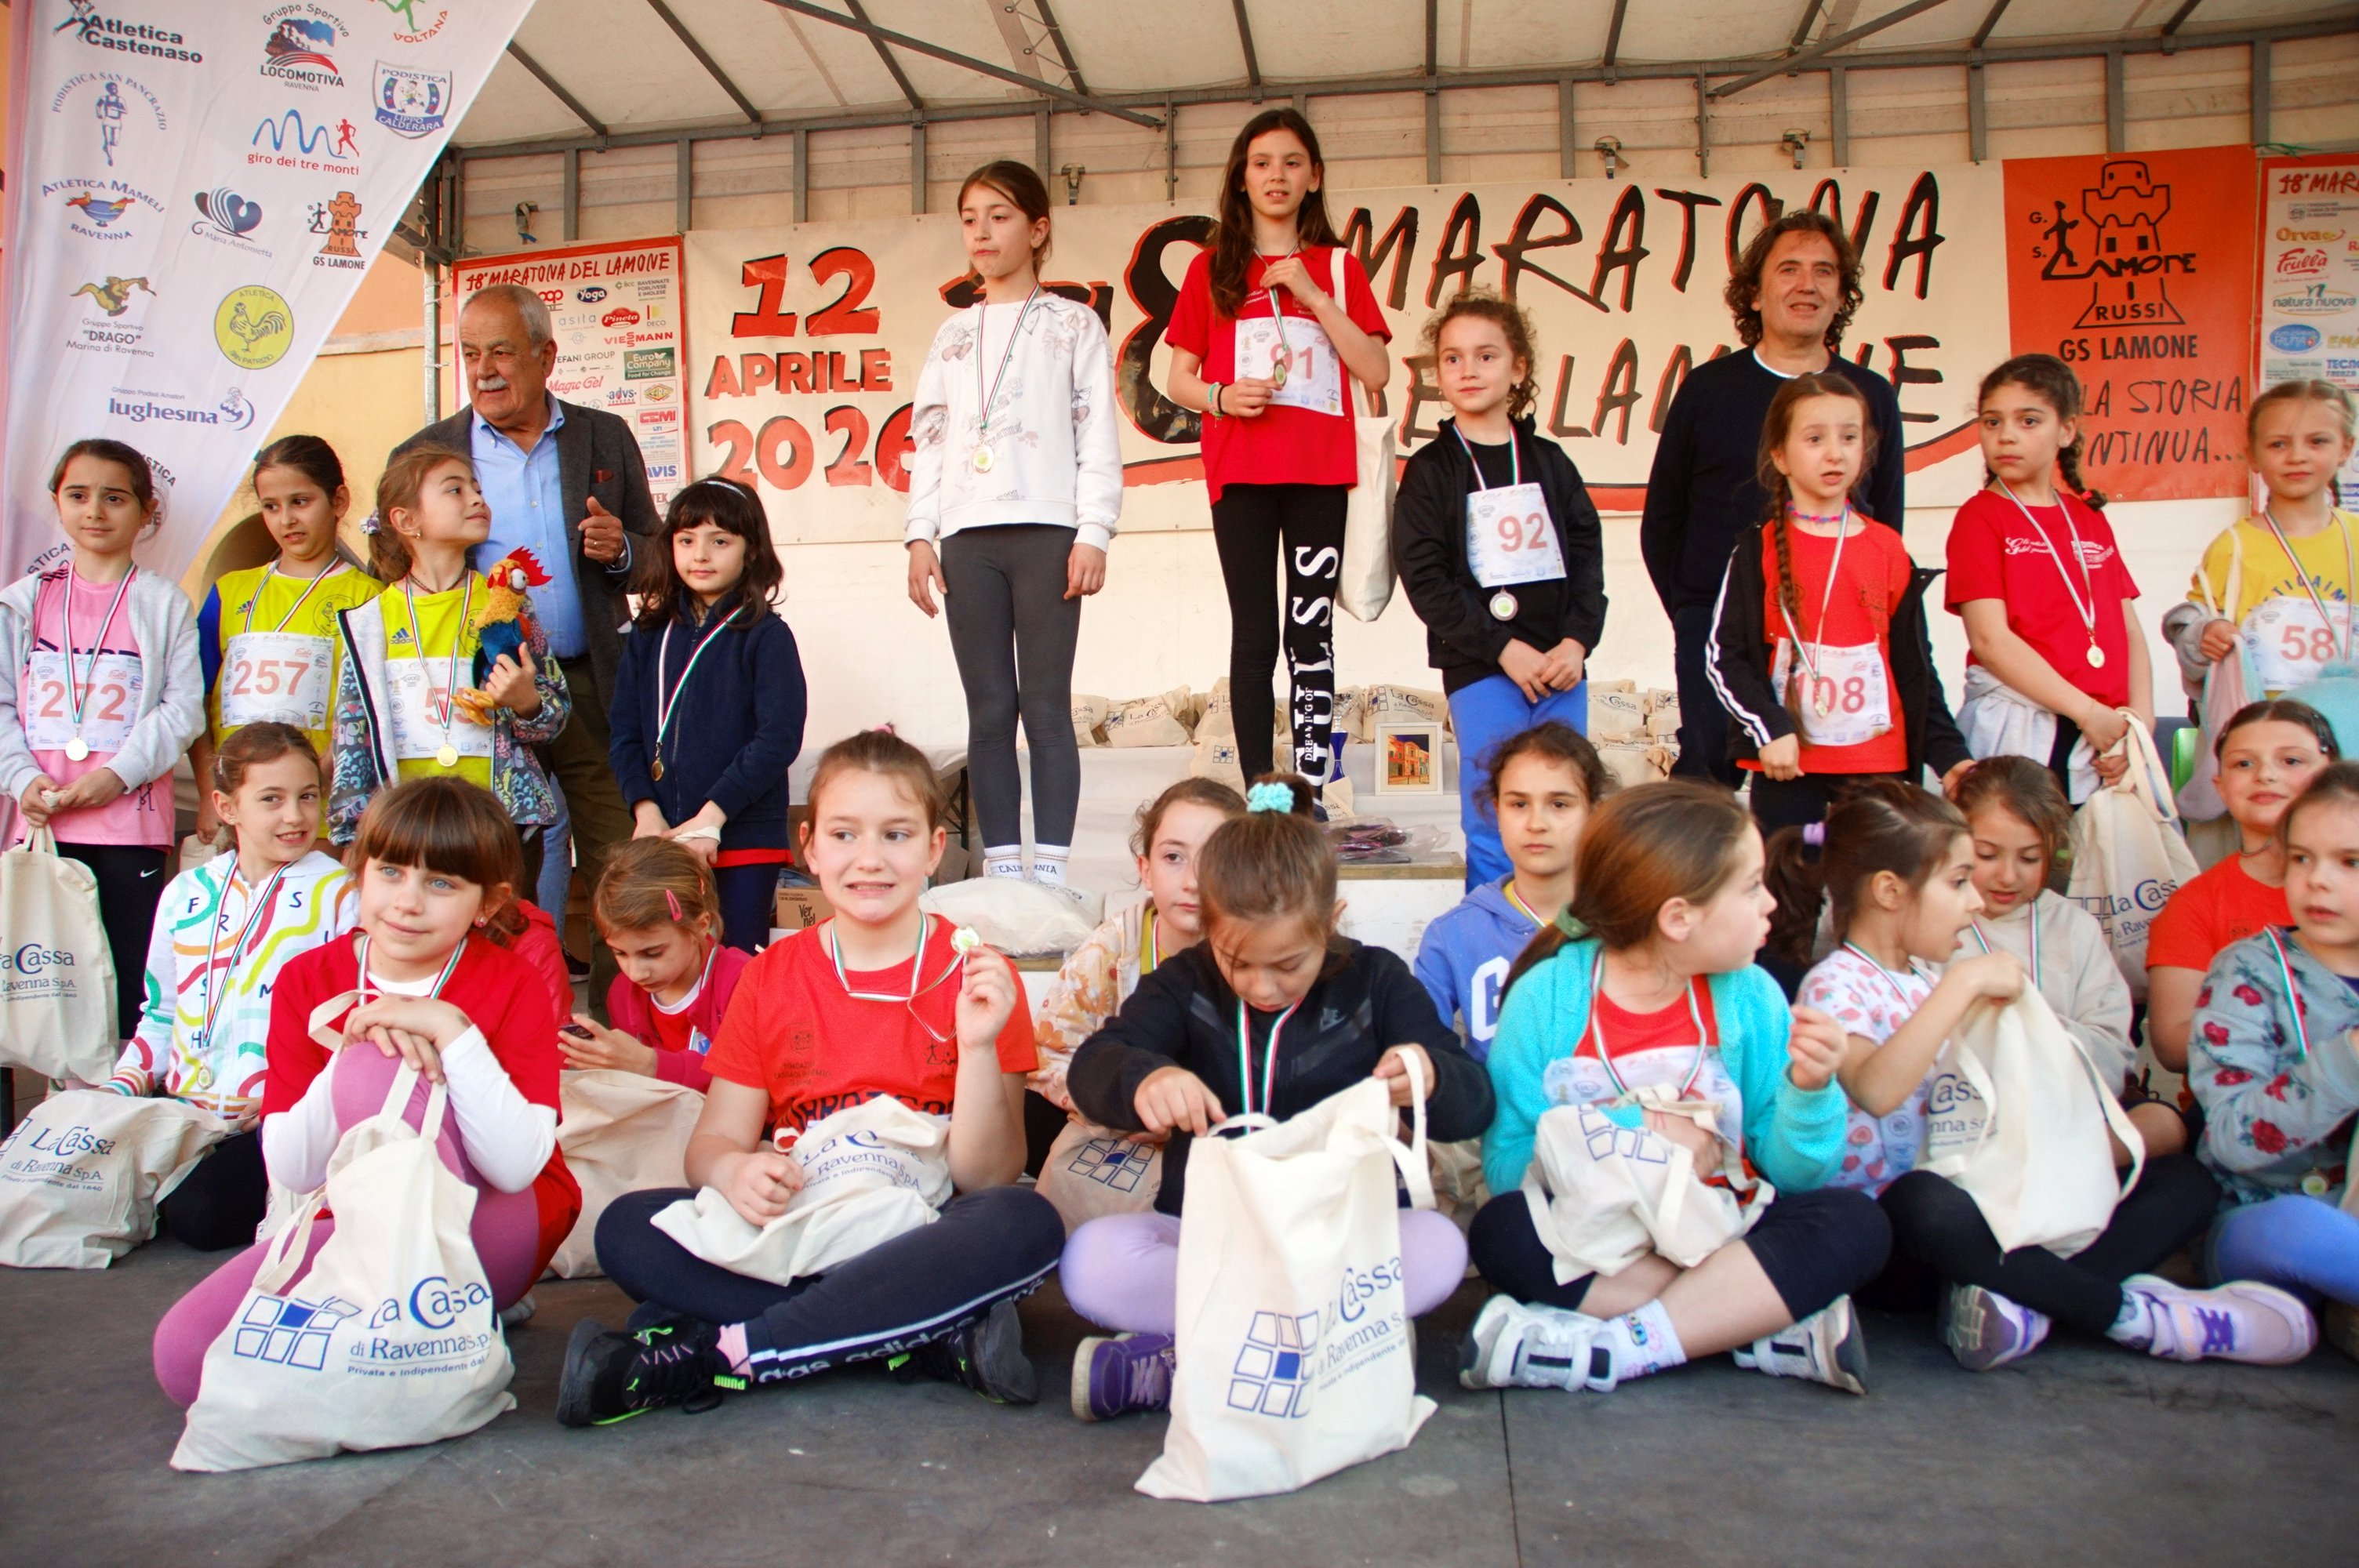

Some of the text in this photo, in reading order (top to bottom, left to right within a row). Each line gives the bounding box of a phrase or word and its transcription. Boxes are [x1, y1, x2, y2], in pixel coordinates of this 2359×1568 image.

[89, 14, 184, 45] Atletica
[263, 3, 350, 38] Gruppo Sportivo
[394, 10, 448, 44] VOLTANA
[85, 30, 203, 64] Castenaso
[260, 65, 345, 88] LOCOMOTIVA
[284, 81, 320, 93] RAVENNA
[382, 68, 448, 84] PODISTICA
[52, 71, 167, 131] PODISTICA SAN PANCRAZIO
[379, 115, 441, 132] CALDERARA
[394, 114, 424, 124] LIPPO
[247, 152, 360, 176] giro dei tre monti
[42, 179, 165, 212] ATLETICA MAMELI
[71, 223, 133, 240] RAVENNA
[313, 256, 366, 270] GS LAMONE
[489, 263, 565, 285] MARATONA
[570, 261, 600, 279] DEL
[605, 252, 670, 275] LAMONE
[238, 289, 274, 302] ATLETICA
[539, 289, 564, 303] oop
[580, 288, 605, 302] Yoga
[731, 246, 881, 338] 12
[2273, 297, 2357, 307] natura nuova
[604, 314, 638, 323] Pineta
[2095, 302, 2165, 321] RUSSI
[557, 351, 616, 364] EFANI GROUP
[633, 354, 655, 362] Euro
[2059, 334, 2197, 362] GS LAMONE
[627, 359, 671, 369] Company
[1270, 343, 1314, 380] 91
[549, 375, 605, 394] Magic Gel
[704, 348, 893, 400] APRILE
[2128, 376, 2243, 414] STORIA
[108, 397, 219, 425] lughesina
[707, 401, 914, 492] 2026
[2088, 426, 2245, 467] NTINUA...
[1498, 512, 1548, 552] 92
[2280, 625, 2335, 663] 58
[232, 659, 309, 696] 257
[40, 680, 126, 721] 272
[1405, 694, 1434, 710] Cassa
[1608, 695, 1637, 710] Cassa
[187, 897, 199, 914] F
[289, 891, 303, 909] S
[2134, 879, 2178, 911] Cass
[798, 904, 812, 918] Ver
[15, 943, 75, 975] Cassa
[191, 1030, 202, 1049] H
[29, 1126, 117, 1157] La Cassa
[802, 1137, 838, 1168] La
[10, 1159, 73, 1174] di Ravenna
[817, 1152, 899, 1176] Ravenna
[368, 1298, 402, 1330] La
[350, 1335, 466, 1361] di Ravenna
[1326, 1318, 1391, 1367] Ravenna
[347, 1365, 386, 1377] Privata
